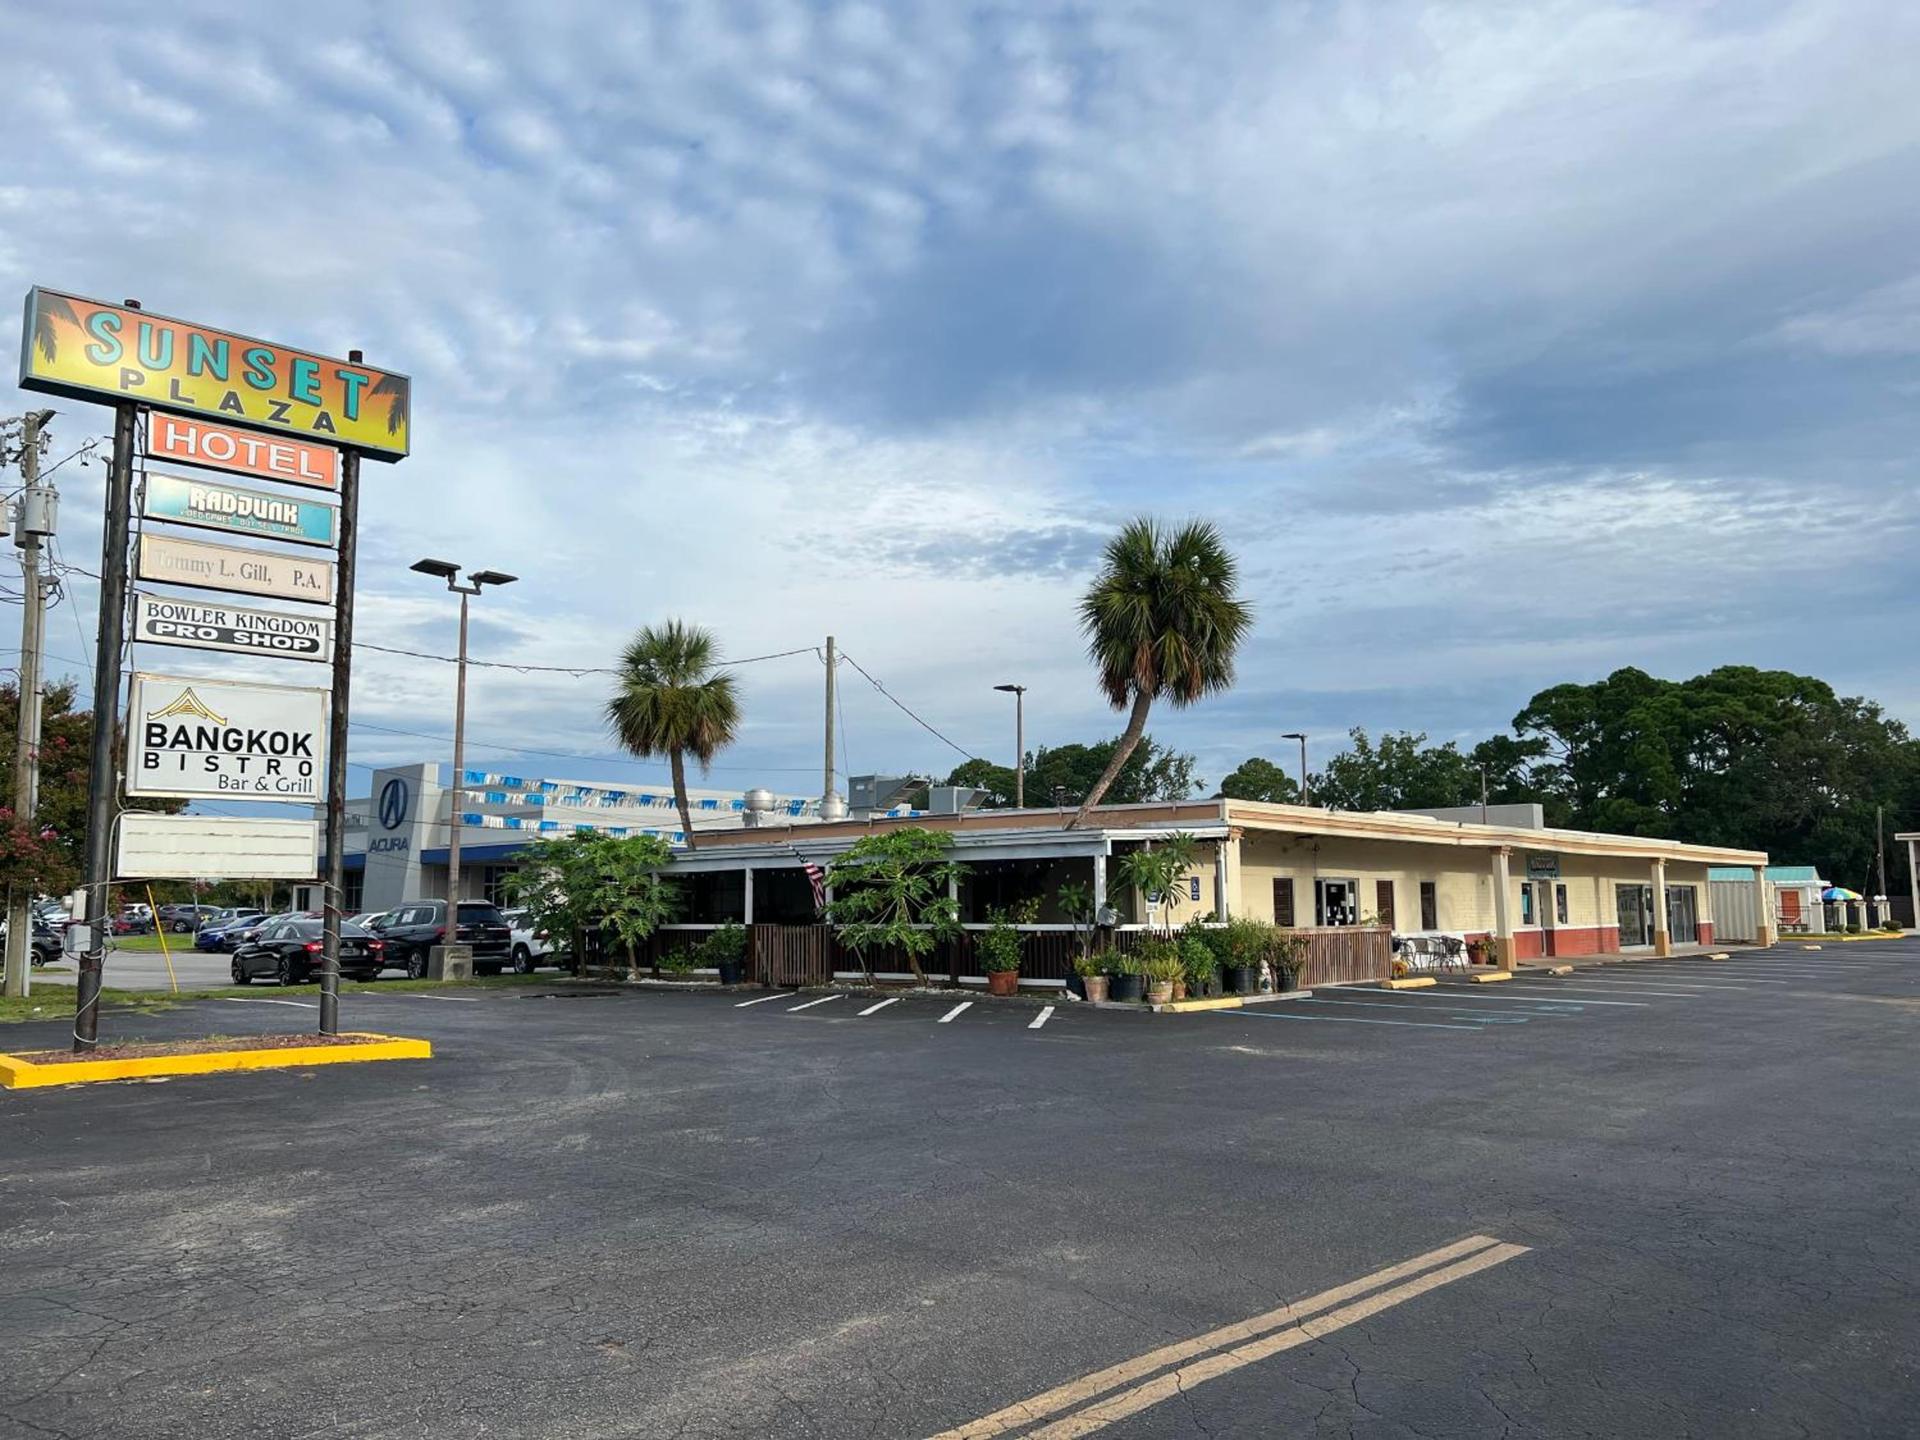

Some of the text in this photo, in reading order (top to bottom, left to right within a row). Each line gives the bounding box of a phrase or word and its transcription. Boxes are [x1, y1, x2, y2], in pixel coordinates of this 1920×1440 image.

[85, 311, 369, 421] SUNSET
[119, 367, 336, 434] PLAZA
[165, 423, 324, 480] HOTEL
[188, 486, 299, 527] RADJUNK
[155, 550, 321, 590] Tommy L. Gill, P.A.
[147, 602, 320, 637] BOWLER KINGDOM
[154, 622, 312, 650] PRO SHOP
[145, 722, 312, 757] BANGKOK
[144, 752, 313, 777] BISTRO
[218, 774, 312, 793] Bar & Grill
[368, 836, 409, 853] ACURA
